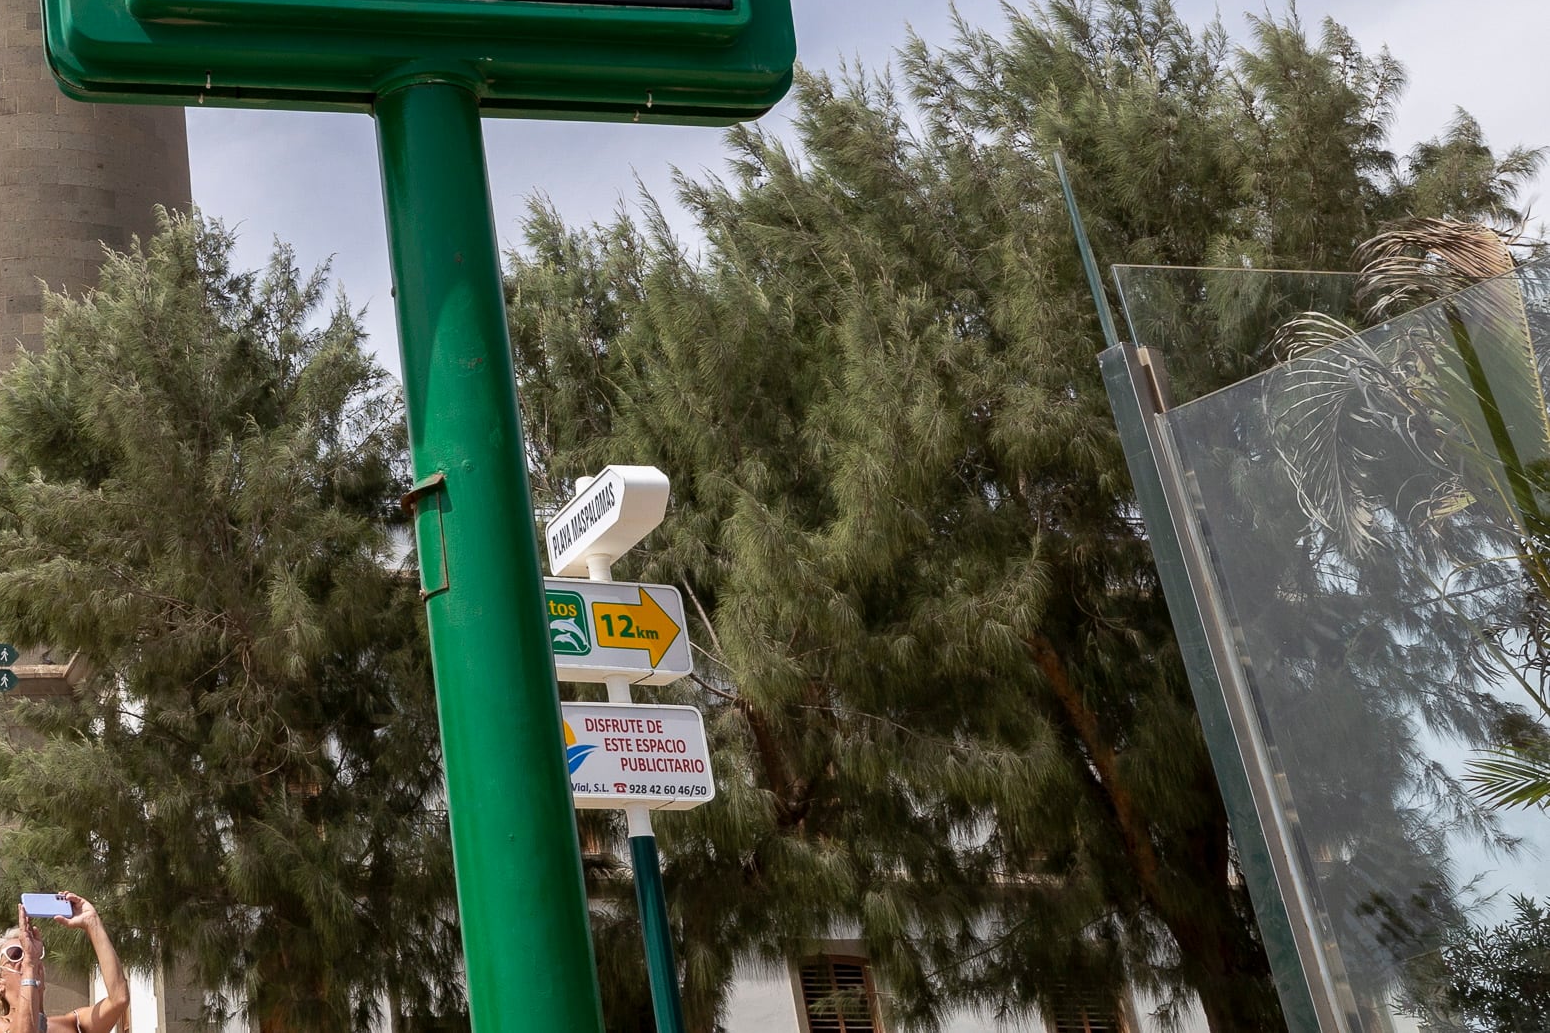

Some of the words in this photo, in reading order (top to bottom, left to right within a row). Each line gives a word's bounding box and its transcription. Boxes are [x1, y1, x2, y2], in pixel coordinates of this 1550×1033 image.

[551, 523, 573, 560] PLAYA
[570, 481, 616, 543] MASPALOMAS
[547, 599, 578, 618] tos
[584, 718, 645, 734] DISFRUTE
[647, 719, 664, 734] DE
[604, 737, 633, 753] ESTE
[635, 738, 687, 754] ESPACIO
[620, 757, 705, 774] PUBLICITARIO
[571, 782, 592, 794] Vial,
[593, 782, 610, 793] S.L.
[629, 784, 647, 795] 928
[649, 784, 662, 795] 42
[663, 785, 676, 795] 60
[678, 785, 707, 797] 46/50
